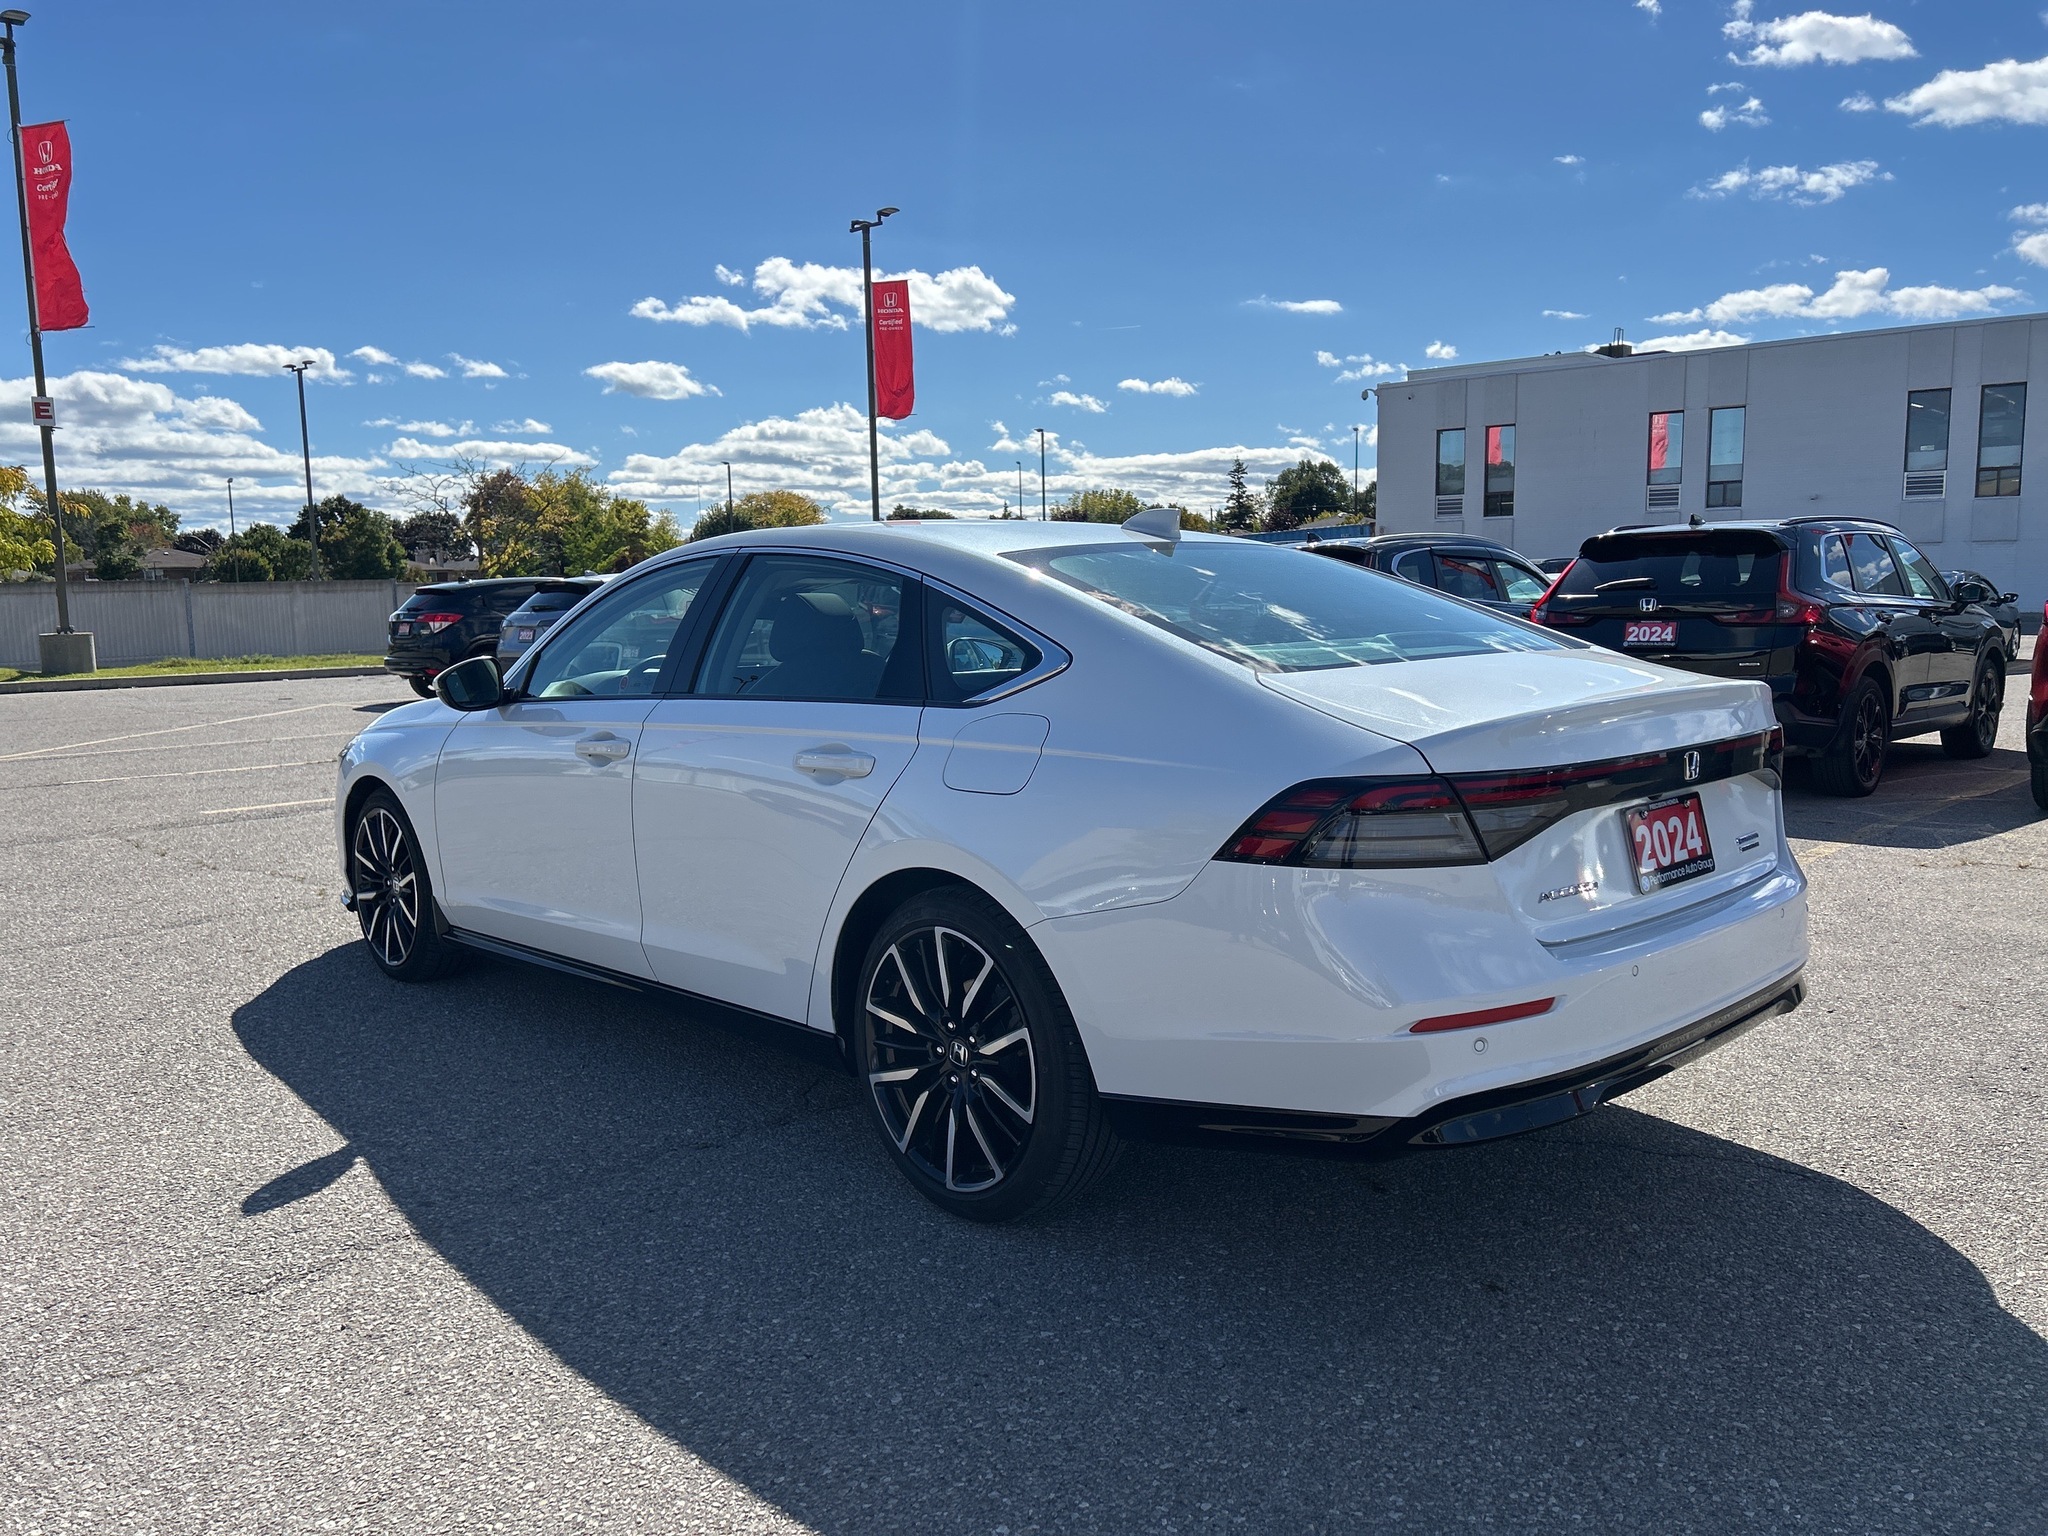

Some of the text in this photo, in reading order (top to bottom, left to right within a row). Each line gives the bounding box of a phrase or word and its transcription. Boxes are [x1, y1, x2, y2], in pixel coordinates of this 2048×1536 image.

[34, 402, 53, 419] E
[1627, 626, 1672, 641] 2024
[1636, 812, 1703, 871] 2024
[1649, 858, 1714, 886] Performance Auto Group
